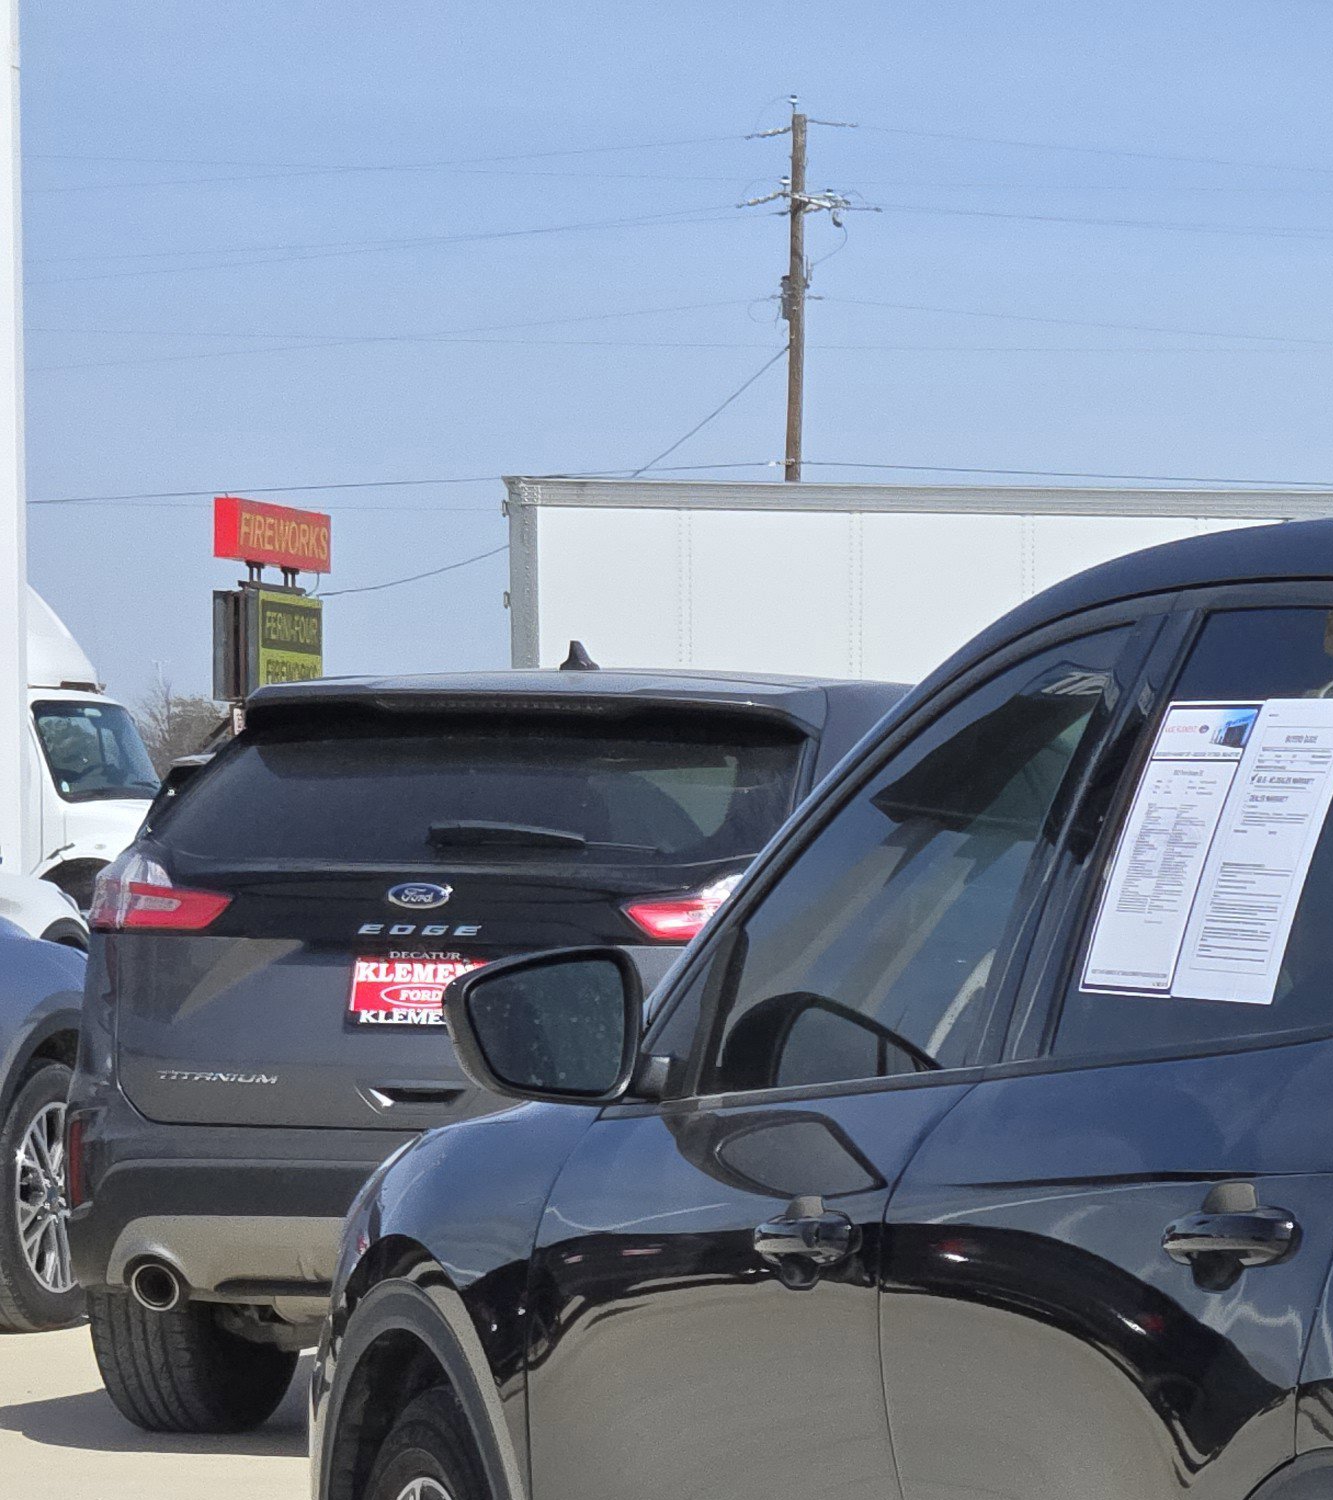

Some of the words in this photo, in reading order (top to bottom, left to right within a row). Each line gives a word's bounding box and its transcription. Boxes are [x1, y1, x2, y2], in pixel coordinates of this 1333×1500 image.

[239, 511, 328, 561] FIREWORKS
[400, 887, 434, 904] Ford
[357, 923, 482, 936] EDGE
[389, 951, 462, 961] DECATUR
[359, 1009, 446, 1025] KLEME
[157, 1070, 279, 1084] TITANIUM
